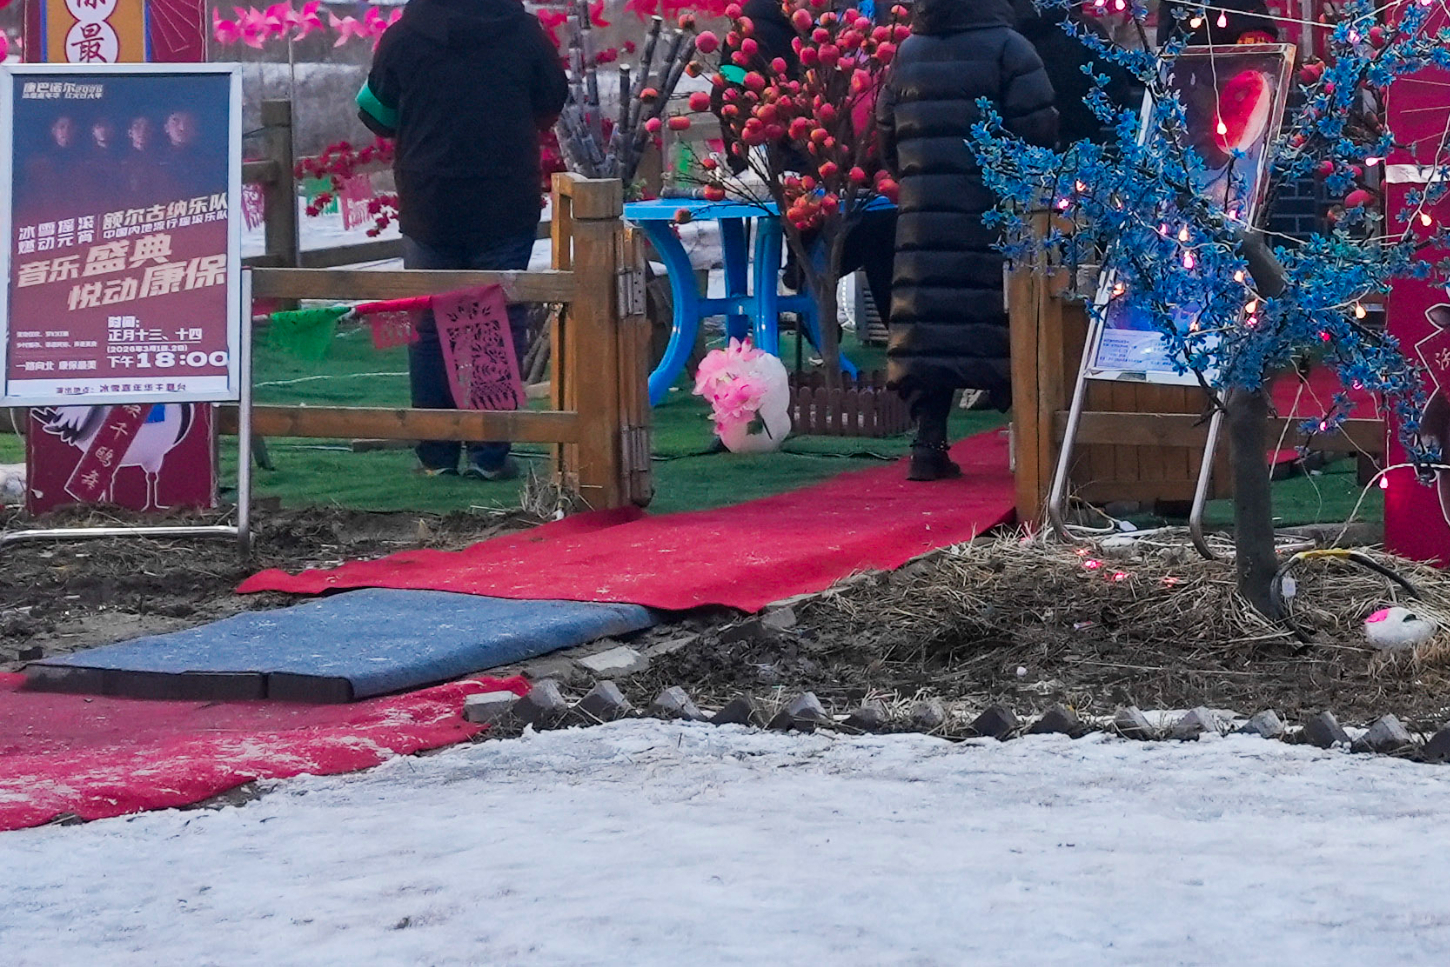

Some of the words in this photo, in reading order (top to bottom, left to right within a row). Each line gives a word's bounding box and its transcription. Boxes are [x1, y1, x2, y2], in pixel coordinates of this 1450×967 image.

[103, 192, 228, 229] 额尔古纳乐队
[18, 230, 95, 254] 燃动元宵
[19, 215, 95, 240] 冰雪摇滚
[18, 233, 172, 288] 音乐盛典
[67, 254, 227, 311] 悦动康保
[108, 328, 203, 342] 正月十三、十四
